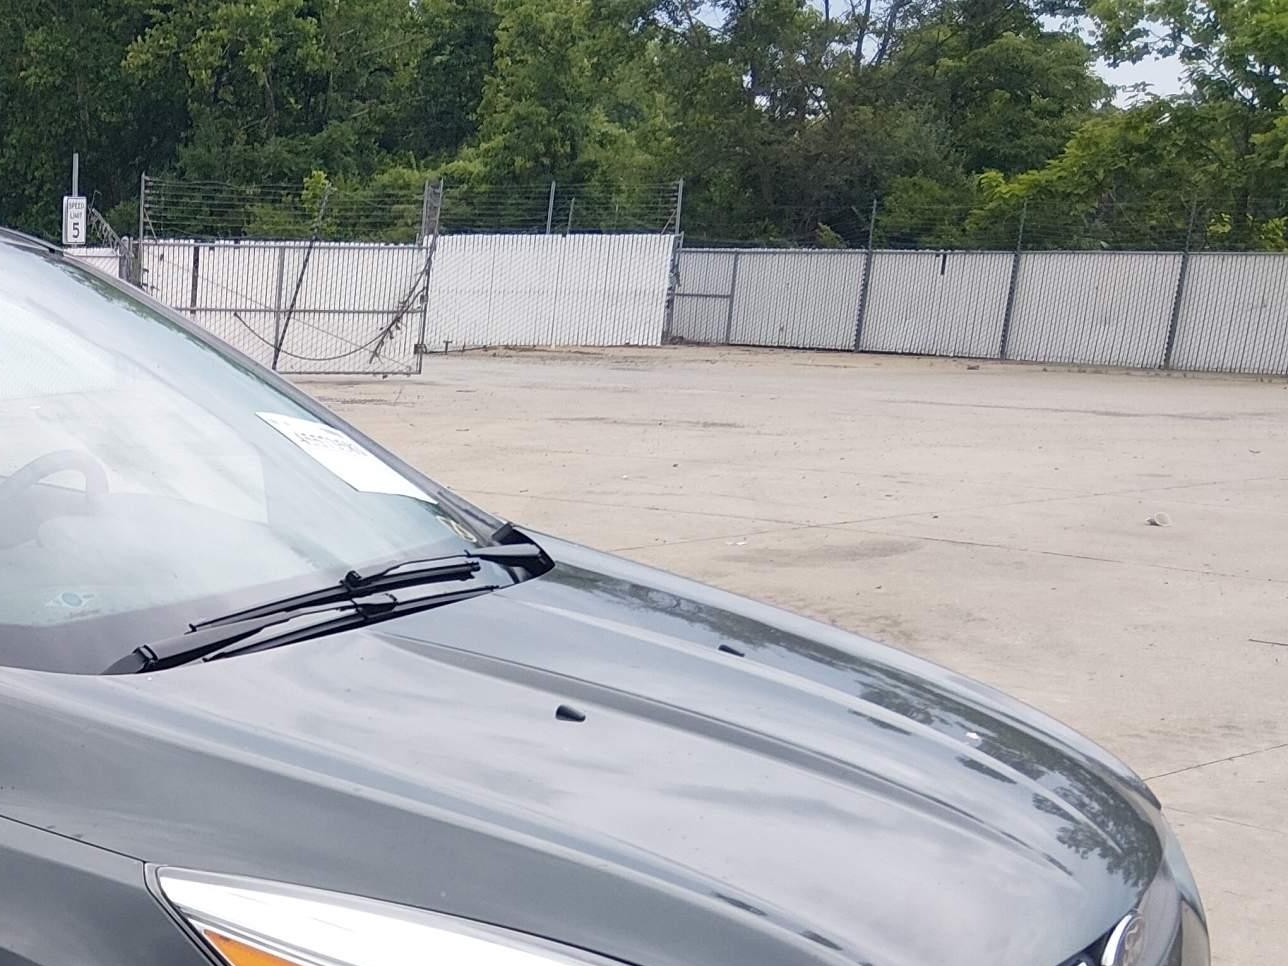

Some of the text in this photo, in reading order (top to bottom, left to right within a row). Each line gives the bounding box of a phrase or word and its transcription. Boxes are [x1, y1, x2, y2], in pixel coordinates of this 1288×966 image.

[68, 202, 84, 210] SPEED
[69, 211, 82, 219] LIMIT
[72, 222, 80, 239] 5
